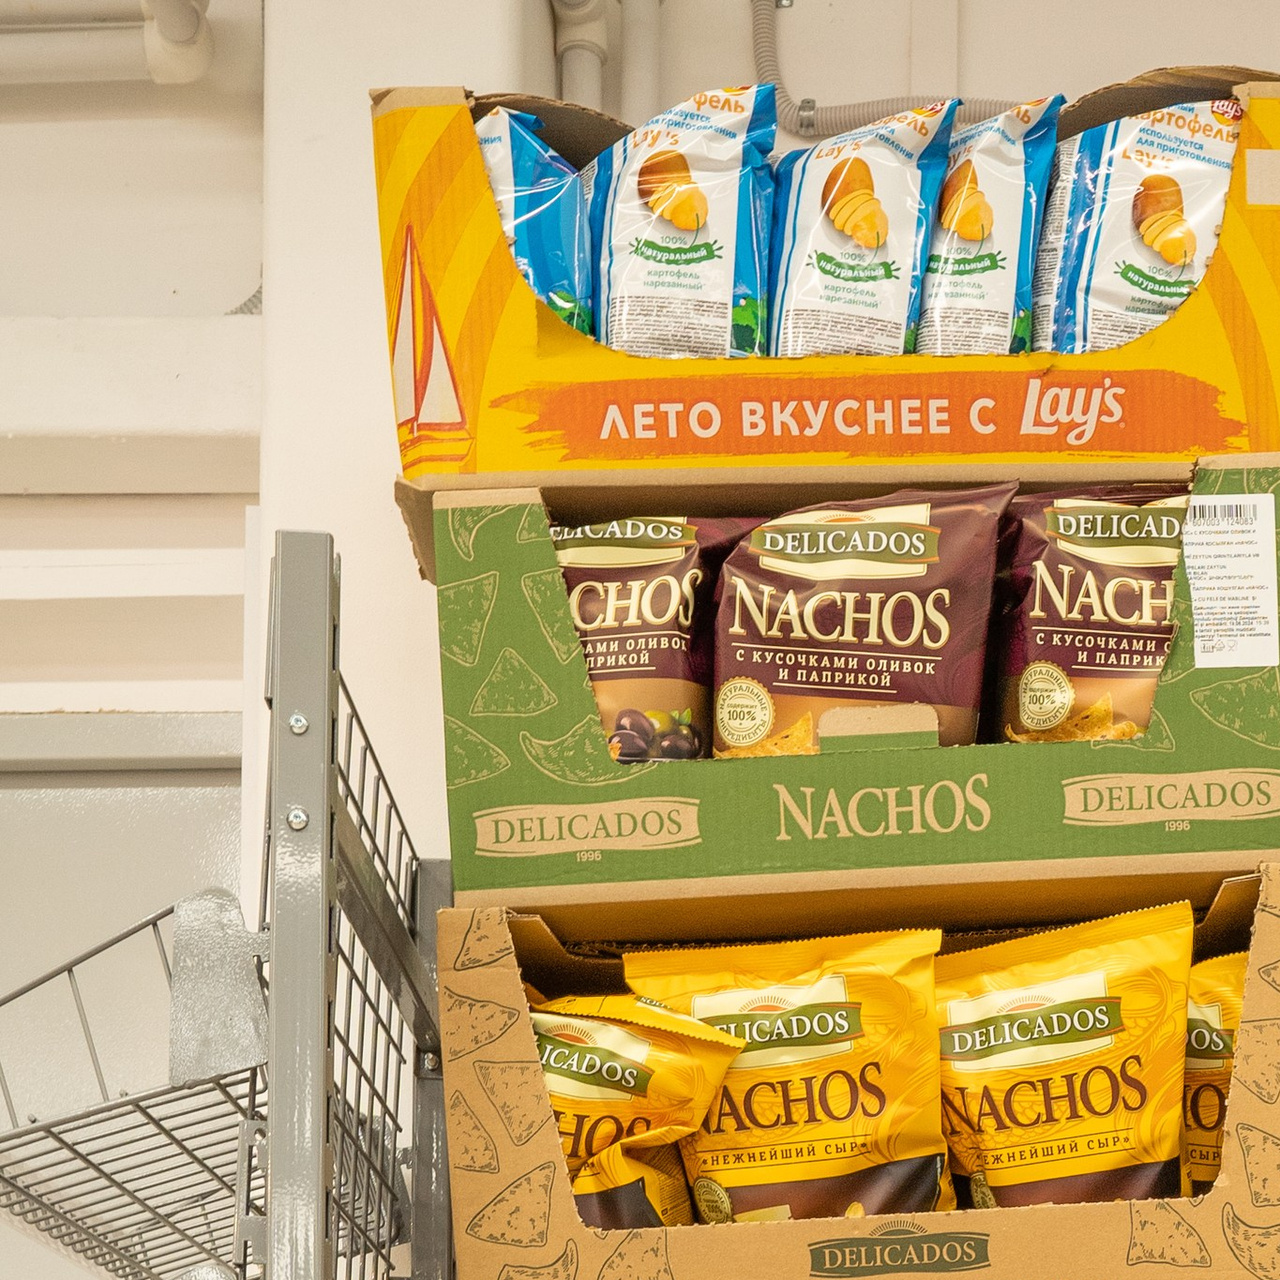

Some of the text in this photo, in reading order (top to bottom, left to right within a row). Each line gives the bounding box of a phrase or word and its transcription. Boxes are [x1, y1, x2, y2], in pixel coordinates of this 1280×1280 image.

[1136, 136, 1149, 146] для
[1139, 126, 1204, 151] используется
[660, 235, 688, 245] 100%
[640, 243, 708, 261] натуральный
[840, 251, 867, 263] 100%
[647, 268, 701, 281] картофель
[819, 259, 885, 277] натуральный
[824, 283, 877, 298] картофель
[599, 377, 1126, 446] ЛЕТО ВКУСНЕЕ С Lay's
[763, 530, 926, 557] DELICADOS
[728, 576, 952, 650] NACHOS
[1036, 631, 1156, 652] С КУСОЧКАМИ
[735, 649, 937, 675] С КУСОЧКАМИ ОЛИВОК
[1078, 651, 1087, 663] И
[778, 668, 892, 687] И ПАПРИКОЙ
[726, 709, 757, 721] 100%
[1078, 778, 1275, 813] DELICADOS
[775, 774, 993, 843] NACHOS
[490, 810, 686, 847] DELICADOS
[1164, 818, 1193, 832] 1996
[574, 849, 603, 863] 1996
[952, 1006, 1109, 1053] DELICADOS
[824, 1141, 867, 1155] СЫР»
[1087, 1135, 1131, 1151] СЫР»
[822, 1240, 977, 1270] DELICADOS
